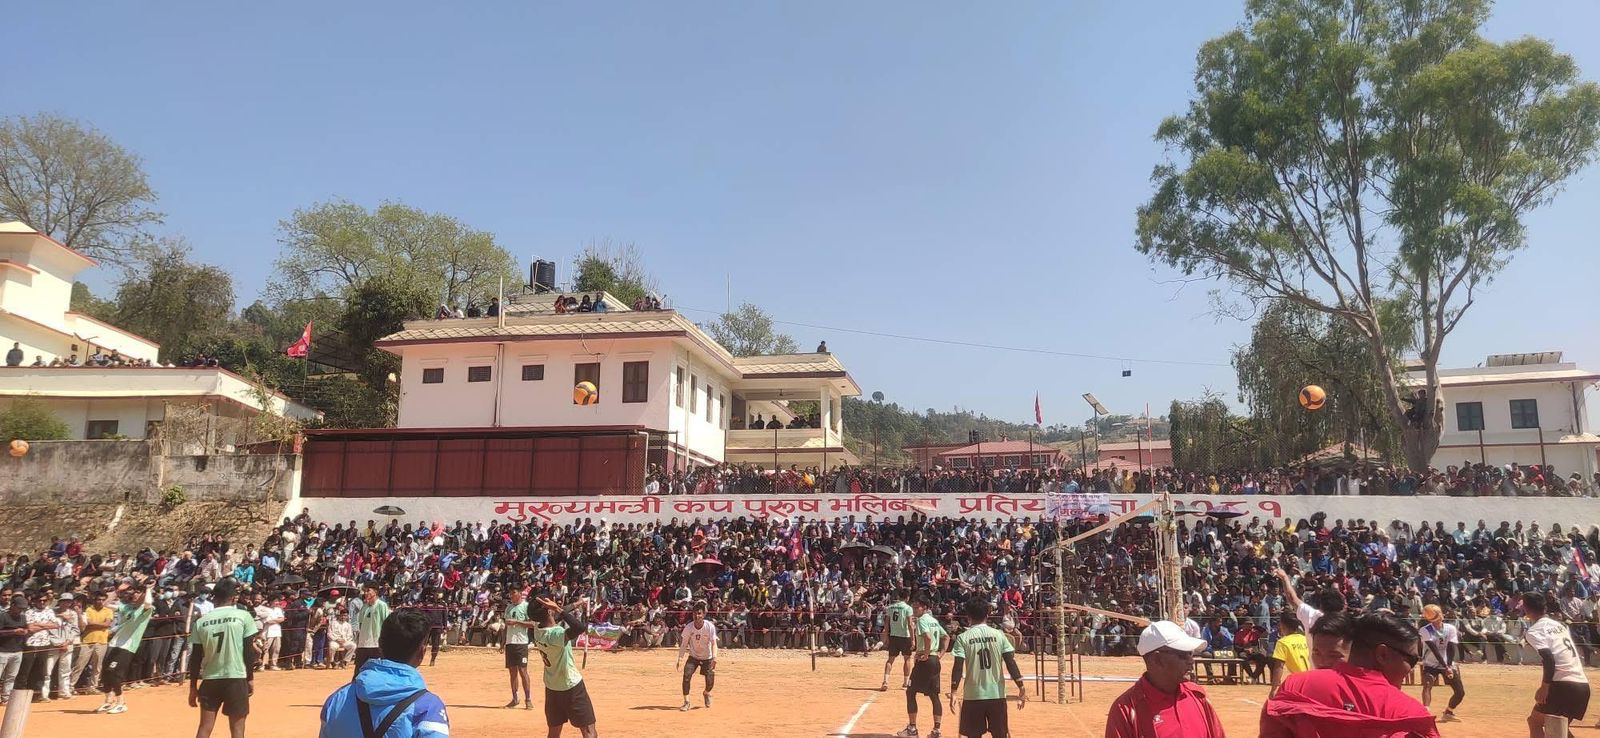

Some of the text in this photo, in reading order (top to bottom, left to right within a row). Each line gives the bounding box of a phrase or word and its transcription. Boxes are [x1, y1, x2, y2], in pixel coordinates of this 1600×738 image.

[672, 500, 734, 513] कप
[893, 611, 900, 622] 6
[212, 631, 225, 653] 7
[977, 648, 991, 670] 10
